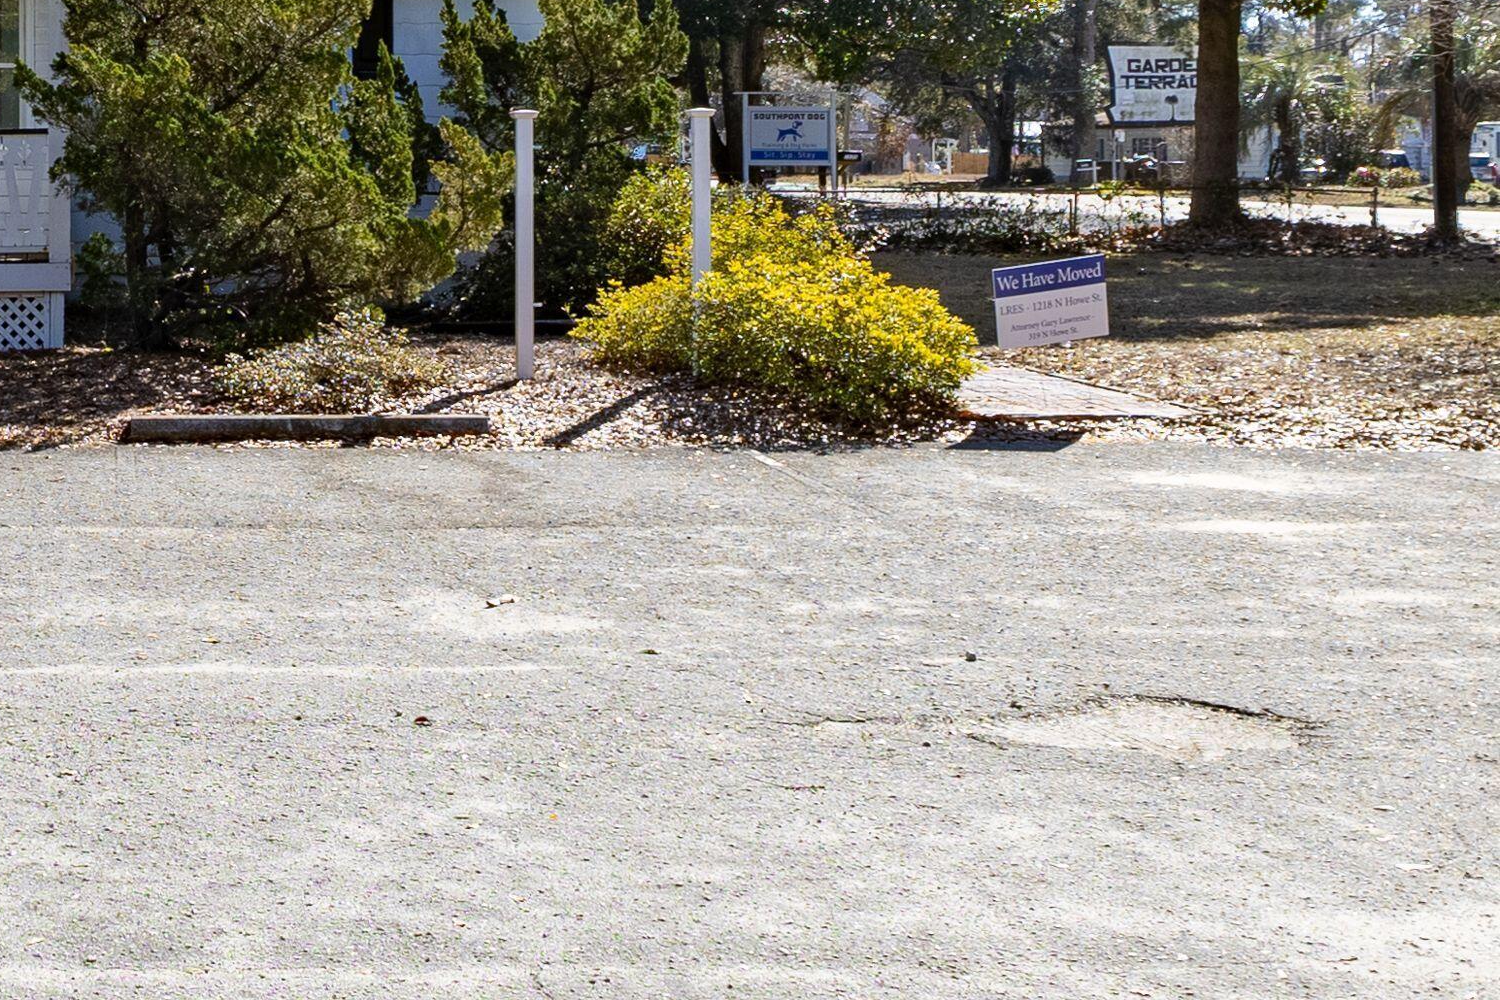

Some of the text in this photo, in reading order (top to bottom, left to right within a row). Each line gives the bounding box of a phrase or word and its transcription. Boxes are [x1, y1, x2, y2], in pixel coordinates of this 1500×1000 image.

[1127, 58, 1197, 73] GARDE
[1120, 74, 1197, 90] TERRAC
[996, 262, 1102, 291] We Have Moved
[1000, 304, 1024, 316] LRES
[1032, 300, 1053, 312] 1218
[1054, 298, 1062, 308] N
[1065, 296, 1090, 307] Howe
[1010, 322, 1040, 332] Attorney
[1041, 331, 1048, 339] N
